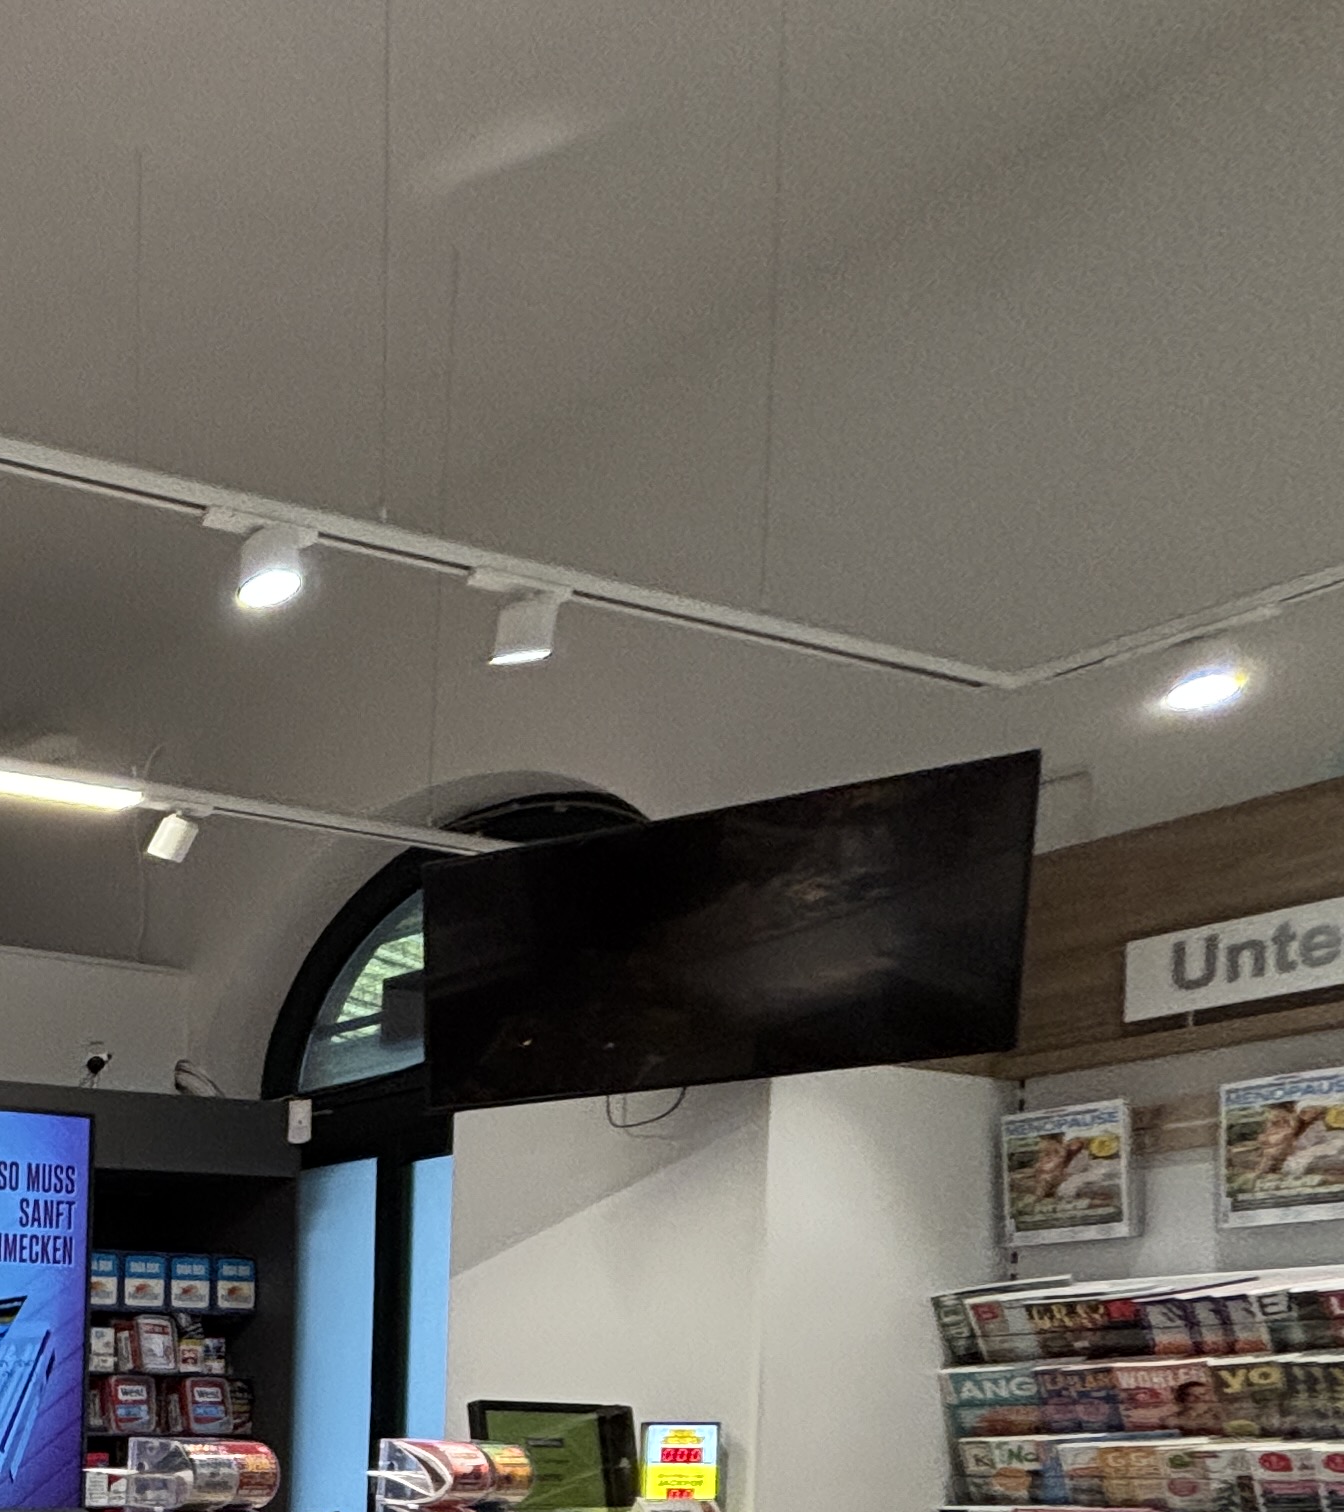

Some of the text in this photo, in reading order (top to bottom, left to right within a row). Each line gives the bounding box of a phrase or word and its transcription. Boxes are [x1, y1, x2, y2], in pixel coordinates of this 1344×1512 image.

[1172, 921, 1343, 991] Unte
[27, 1163, 76, 1194] MUSS
[19, 1198, 75, 1230] SANFT
